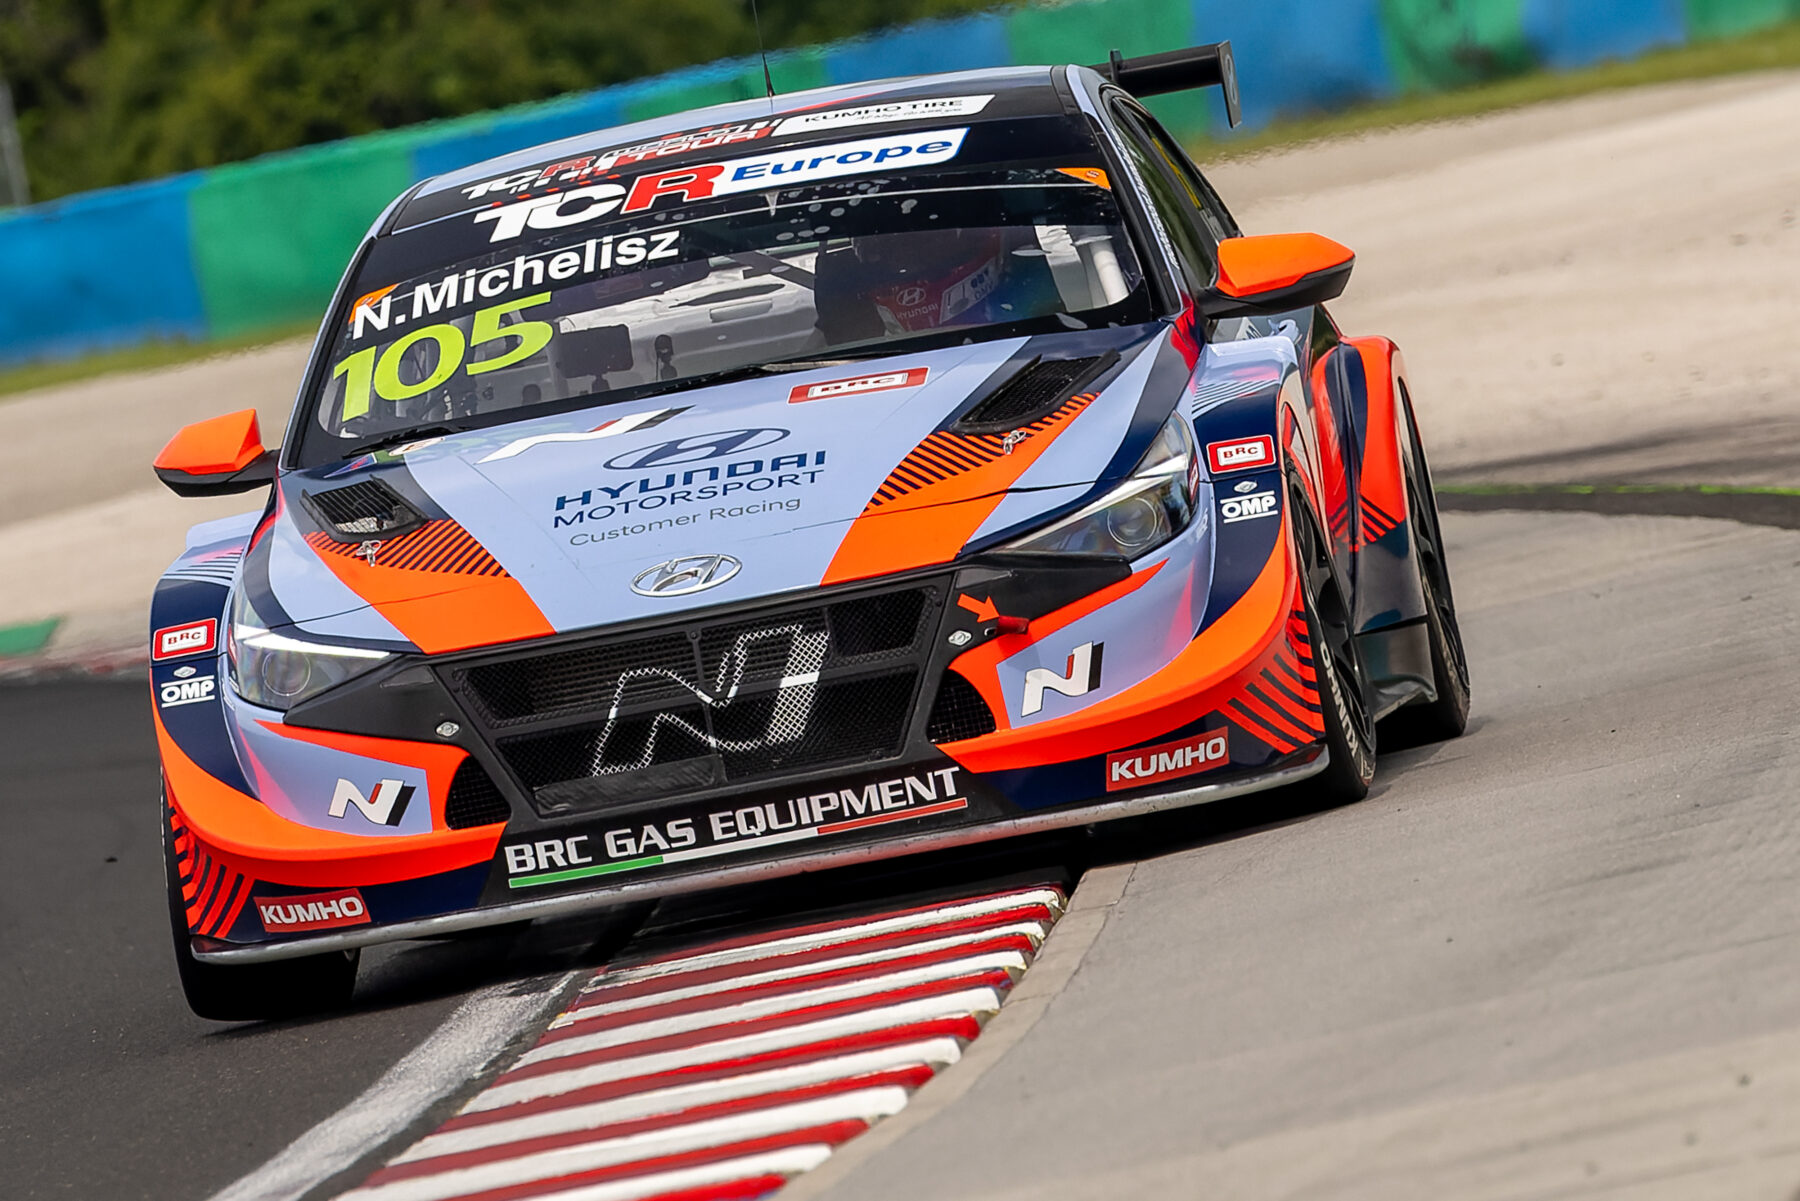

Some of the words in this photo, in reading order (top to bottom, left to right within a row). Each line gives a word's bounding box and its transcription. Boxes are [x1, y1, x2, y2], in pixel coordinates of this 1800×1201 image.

[804, 105, 902, 123] KUMHO
[908, 99, 963, 110] TIRE
[473, 164, 726, 244] TCR
[731, 140, 953, 182] Europe
[352, 230, 681, 341] N.Michelisz
[333, 291, 554, 422] 105
[1222, 446, 1259, 459] BRC
[553, 468, 825, 529] MOTORSPORT
[555, 450, 827, 511] HYUNDAI
[569, 511, 701, 547] Customer
[709, 498, 802, 523] Racing
[1221, 495, 1277, 519] OMP
[167, 631, 202, 645] BRC
[161, 679, 215, 703] OMP
[1111, 736, 1226, 783] KUMHO
[504, 834, 592, 874] BRC
[603, 817, 697, 859] GAS
[709, 766, 961, 841] EQUIPMENT
[259, 895, 365, 926] KUMHO
